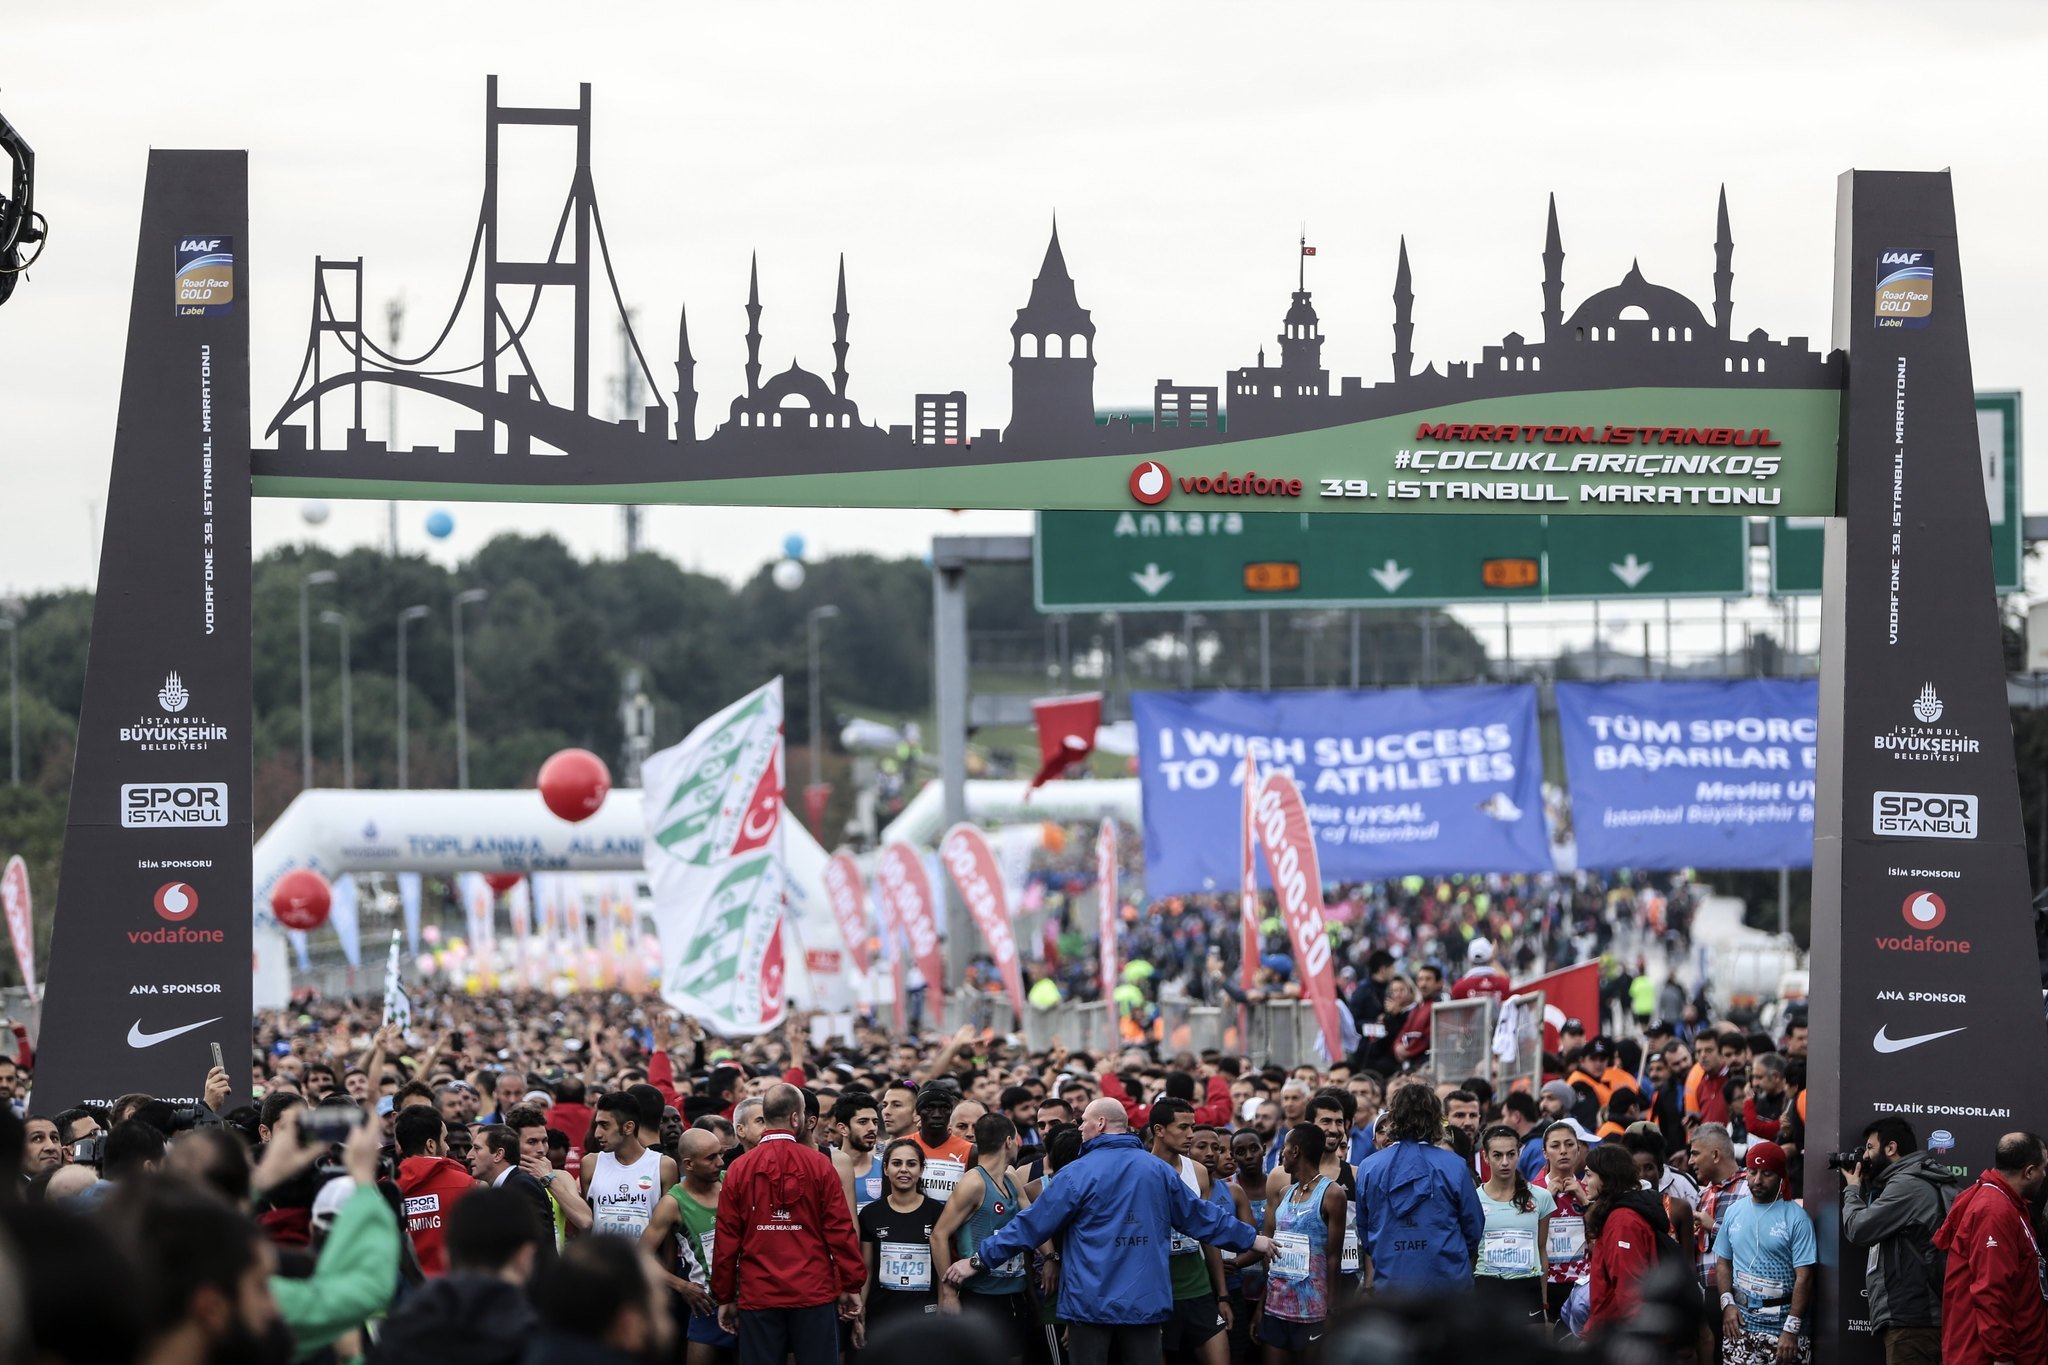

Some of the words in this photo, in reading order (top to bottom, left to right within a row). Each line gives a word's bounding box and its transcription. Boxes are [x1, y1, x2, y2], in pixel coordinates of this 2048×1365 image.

[180, 240, 221, 252] IAAF
[1882, 252, 1923, 265] IAAF
[182, 279, 206, 288] Road
[207, 279, 229, 288] Race
[181, 289, 212, 299] GOLD
[1882, 291, 1906, 300] Road
[1906, 291, 1929, 301] Race
[181, 307, 205, 315] Label
[1880, 301, 1911, 312] GOLD
[1880, 318, 1904, 327] Label
[201, 344, 212, 433] MARATONU
[1895, 356, 1907, 444] MARATONU
[1179, 471, 1303, 496] vodafone
[1320, 479, 1378, 498] 39.
[1580, 484, 1781, 505] MARATONU
[204, 519, 213, 545] 39.
[1114, 512, 1244, 537] Ankara
[1892, 529, 1901, 555] 39.
[204, 548, 215, 635] VODAFONE
[1889, 558, 1900, 645] VODAFONE
[140, 716, 207, 724] İSTANBUL
[120, 724, 228, 744] BÜYÜKŞEHİR
[1587, 715, 1682, 743] TÜM
[1895, 725, 1960, 736] İSTANBUL
[141, 742, 208, 751] BELEDİYESİ
[1159, 727, 1175, 760] I
[1181, 728, 1306, 766] WISH
[1314, 724, 1512, 768] SUCCESS
[1874, 733, 1980, 755] BÜYÜKŞEHİR
[1594, 743, 1792, 771] BAŞARILAR
[1894, 752, 1960, 762] BELEDİYESİ
[1158, 758, 1219, 791] TO
[1314, 752, 1516, 795] ATHLETES
[128, 788, 220, 808] SPOR
[1880, 797, 1971, 820] SPOR
[138, 859, 159, 868] İSİM
[161, 860, 212, 868] SPONSORU
[1888, 867, 1908, 876] İSİM
[1910, 869, 1961, 878] SPONSORU
[127, 927, 224, 944] vodafone
[1875, 935, 1971, 953] vodafone
[129, 985, 159, 995] ANA
[162, 984, 222, 994] SPONSOR
[1876, 991, 1905, 1001] ANA
[1908, 992, 1967, 1003] SPONSOR
[1873, 1103, 1924, 1114] TEDARİK
[1927, 1105, 2010, 1118] SPONSORLARI
[1115, 1236, 1149, 1247] STAFF
[1394, 1240, 1428, 1251] STAFF
[885, 1260, 925, 1275] 15429
